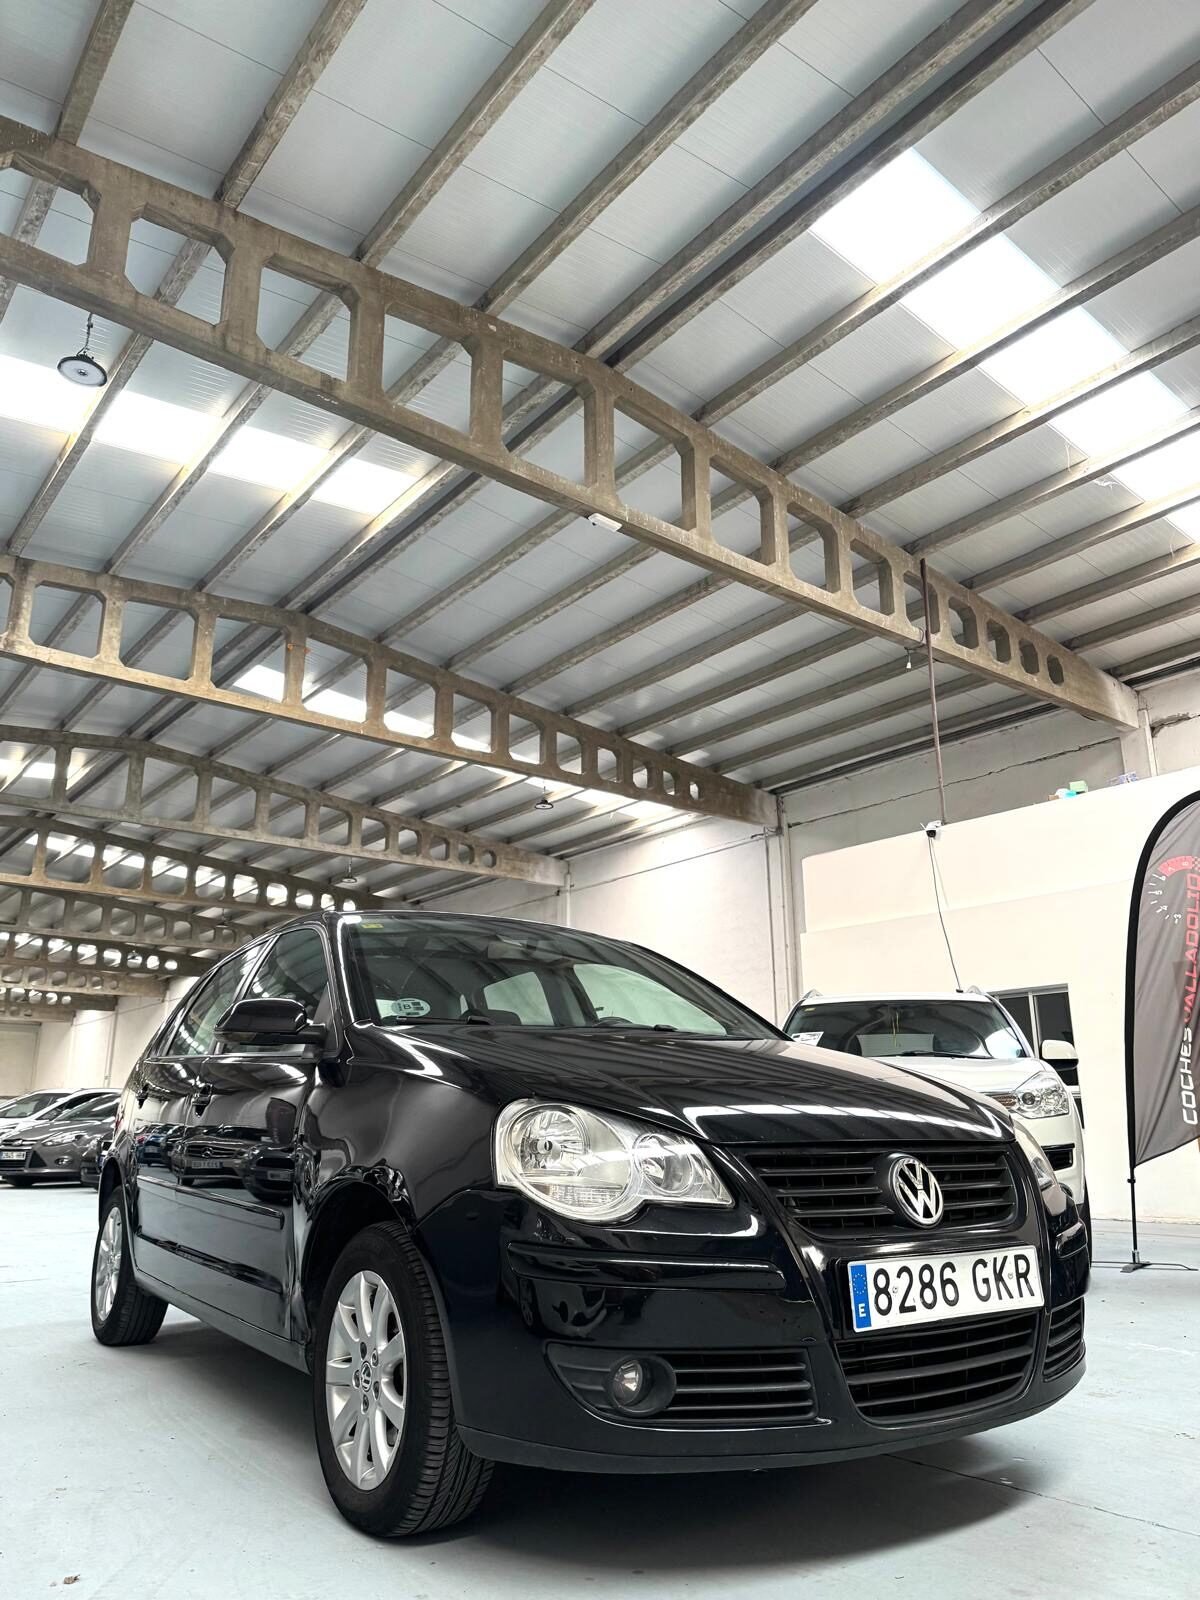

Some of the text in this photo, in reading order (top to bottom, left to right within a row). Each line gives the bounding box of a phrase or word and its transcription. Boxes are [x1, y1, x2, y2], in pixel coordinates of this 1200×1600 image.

[1180, 873, 1200, 1125] COCHES VALLADOLID
[858, 1303, 867, 1318] E
[873, 1254, 1035, 1317] 8286 GKR
